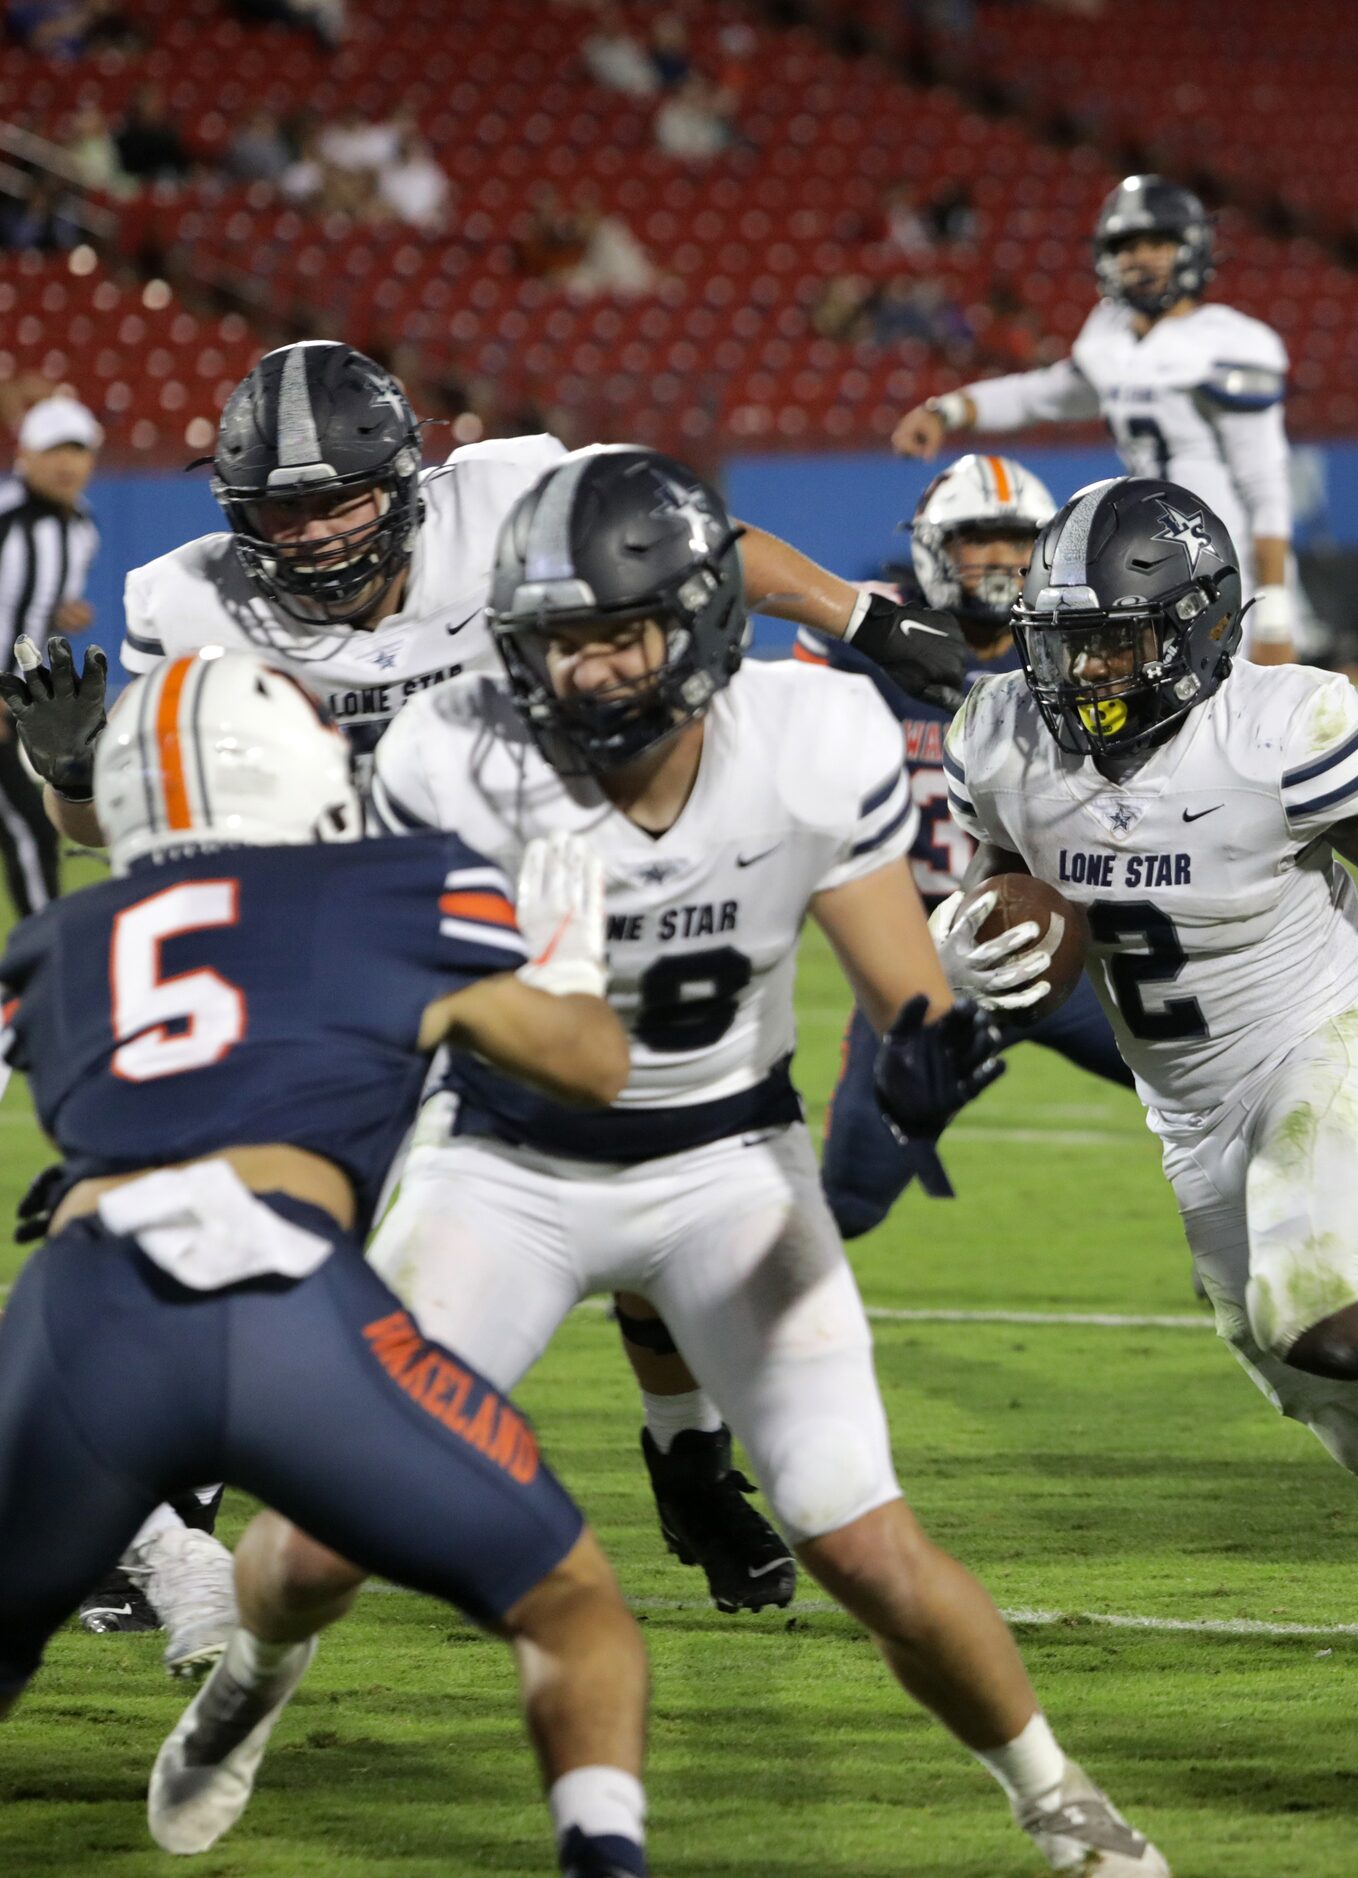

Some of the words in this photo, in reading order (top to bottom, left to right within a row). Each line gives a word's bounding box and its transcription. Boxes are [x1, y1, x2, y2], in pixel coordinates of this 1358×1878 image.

[1158, 514, 1212, 549] LS
[1059, 850, 1116, 887] LONE
[1125, 853, 1191, 888] STAR
[606, 914, 645, 941] NE
[658, 901, 738, 941] STAR
[109, 876, 248, 1083] 5
[635, 946, 752, 1053] 8
[1087, 899, 1212, 1041] 2
